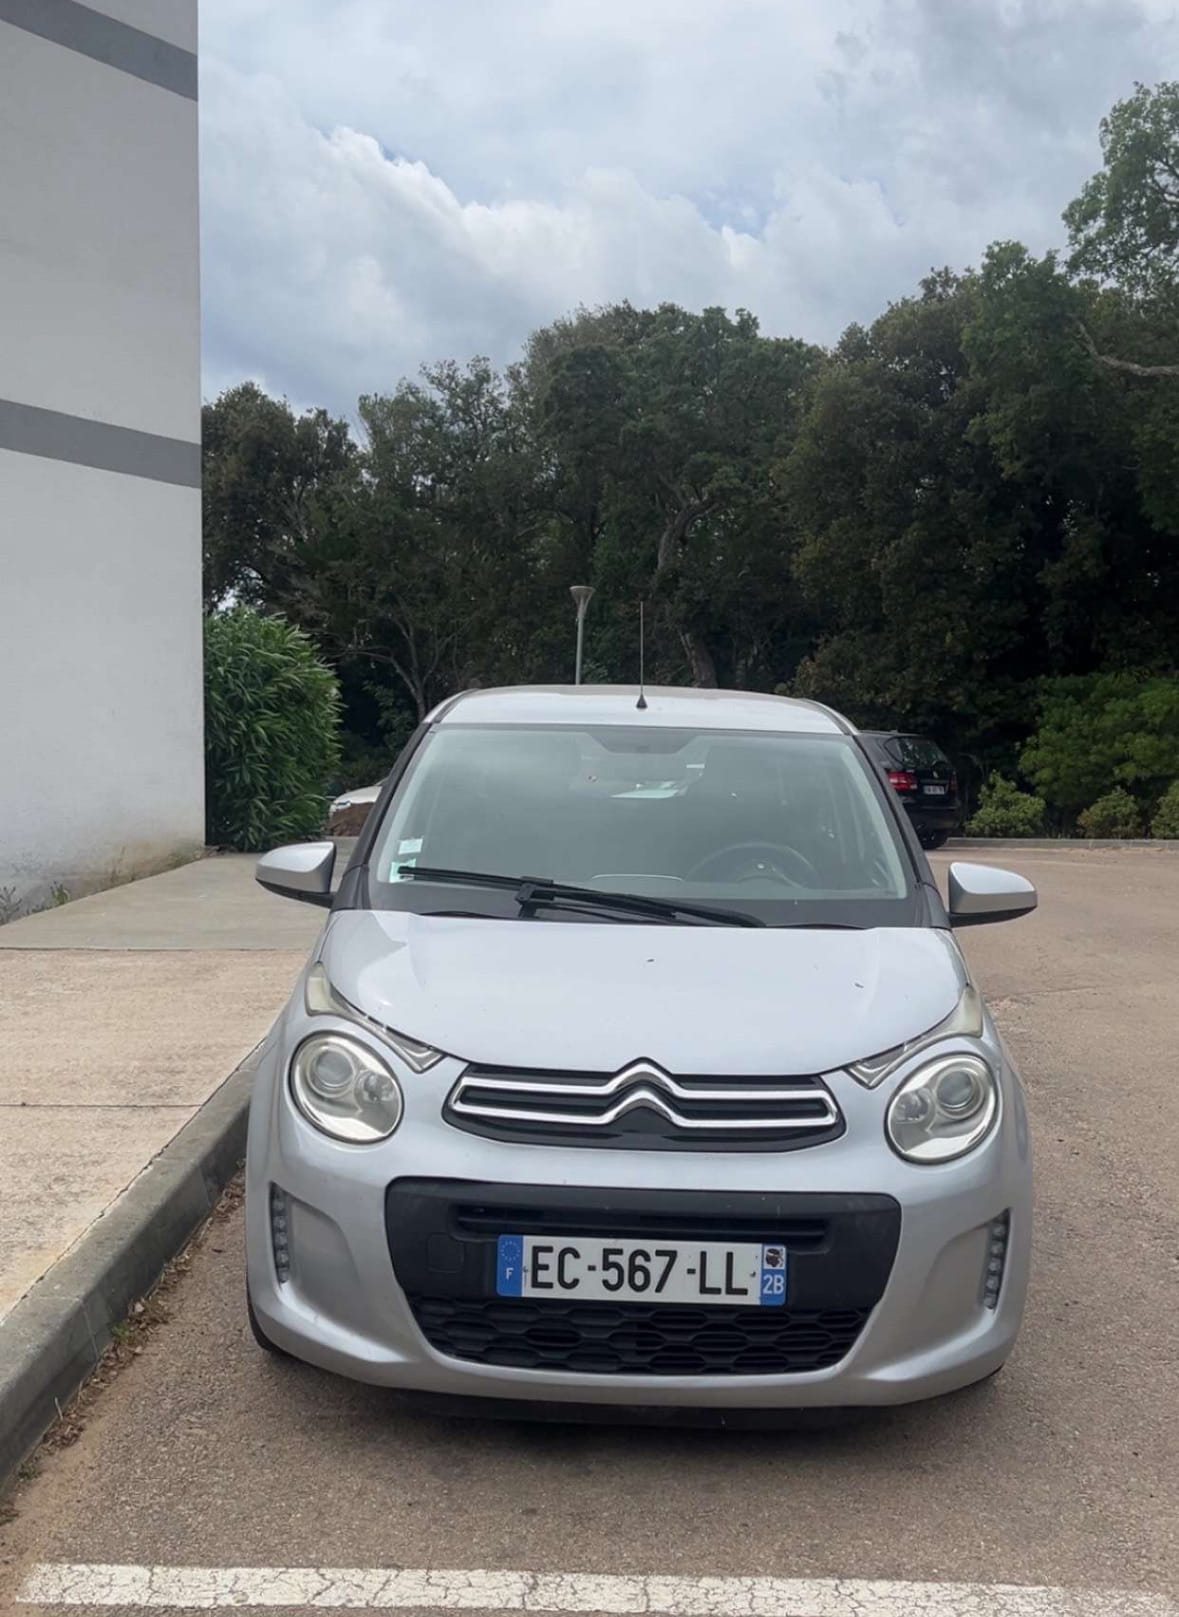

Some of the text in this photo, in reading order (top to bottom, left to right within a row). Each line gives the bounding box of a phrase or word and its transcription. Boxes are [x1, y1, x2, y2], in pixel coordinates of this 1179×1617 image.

[505, 1245, 785, 1296] F EC-567-LL 2B
